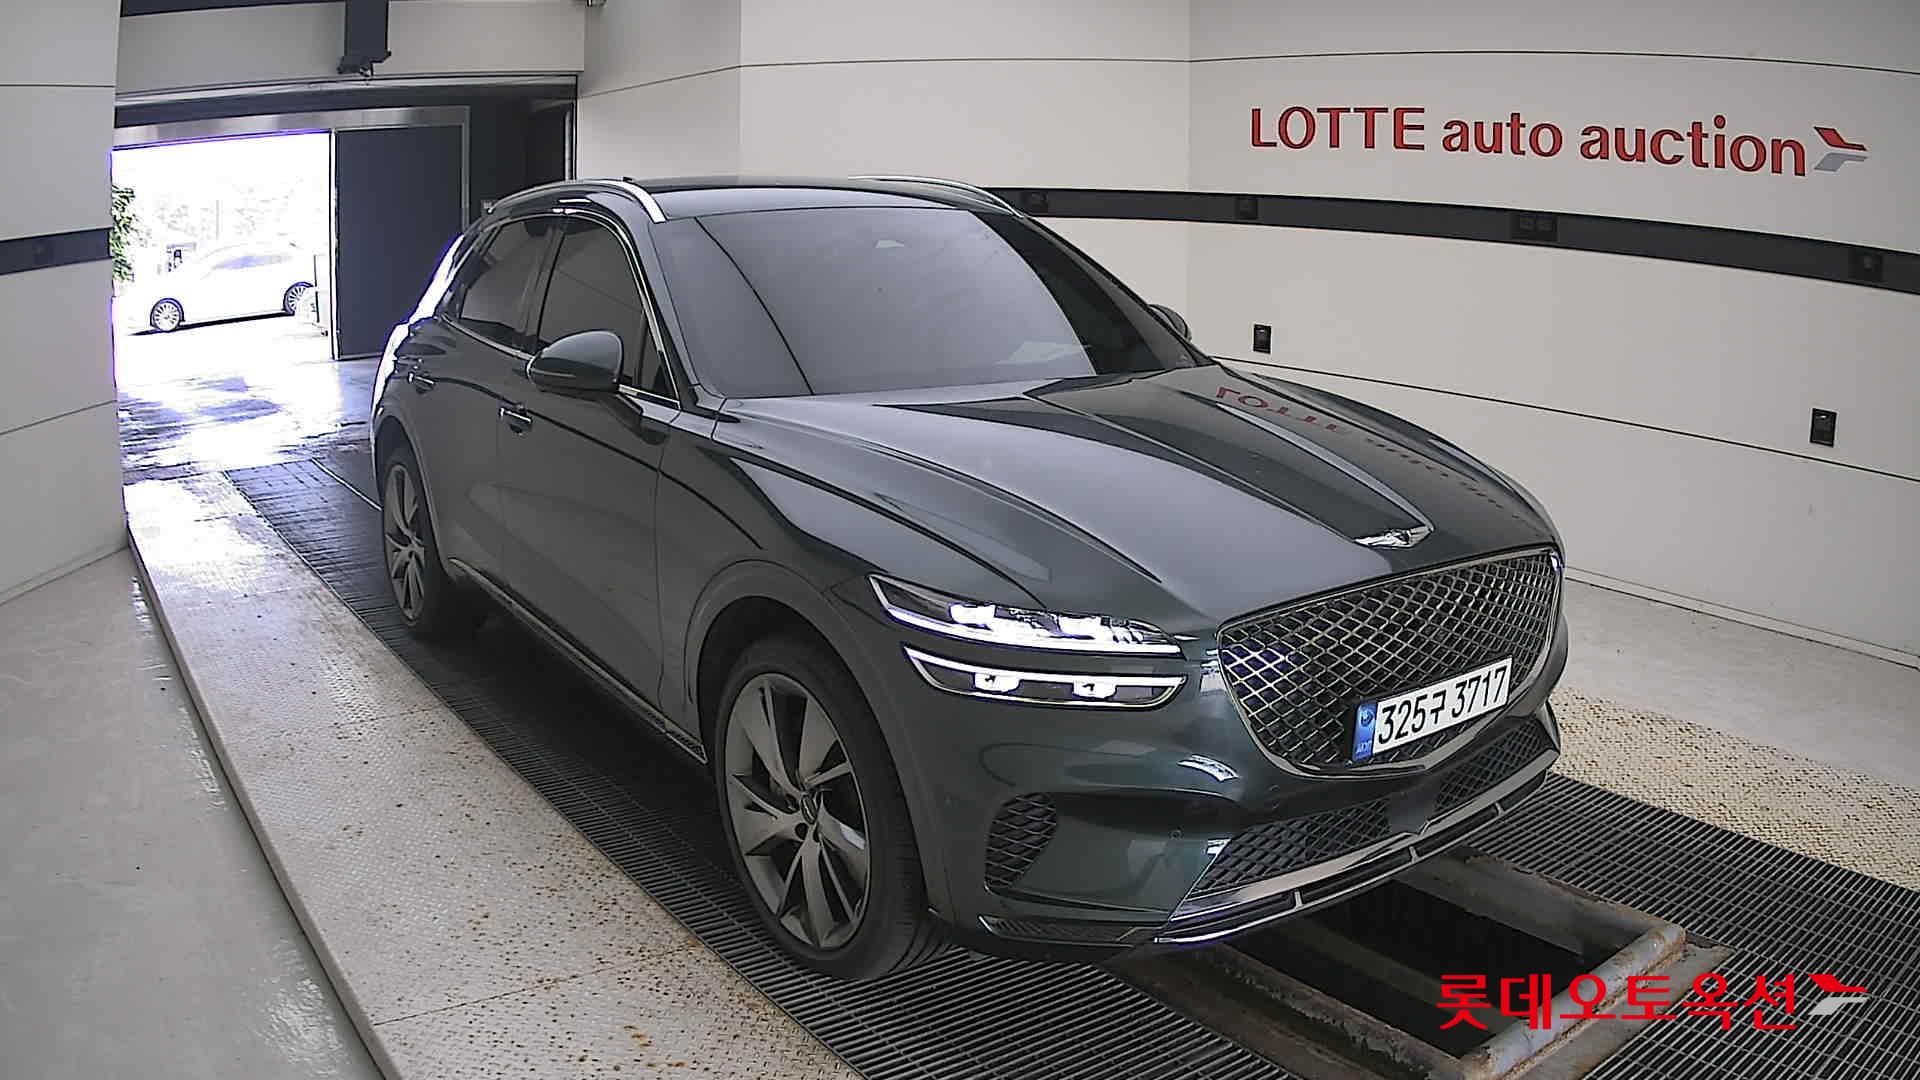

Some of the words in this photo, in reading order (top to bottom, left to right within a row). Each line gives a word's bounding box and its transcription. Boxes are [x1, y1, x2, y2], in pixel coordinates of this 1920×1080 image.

[1251, 106, 1425, 150] LOTTE
[1442, 112, 1563, 158] auto
[1580, 115, 1806, 177] auction
[1378, 690, 1447, 745] 325구
[1451, 666, 1508, 719] 3717
